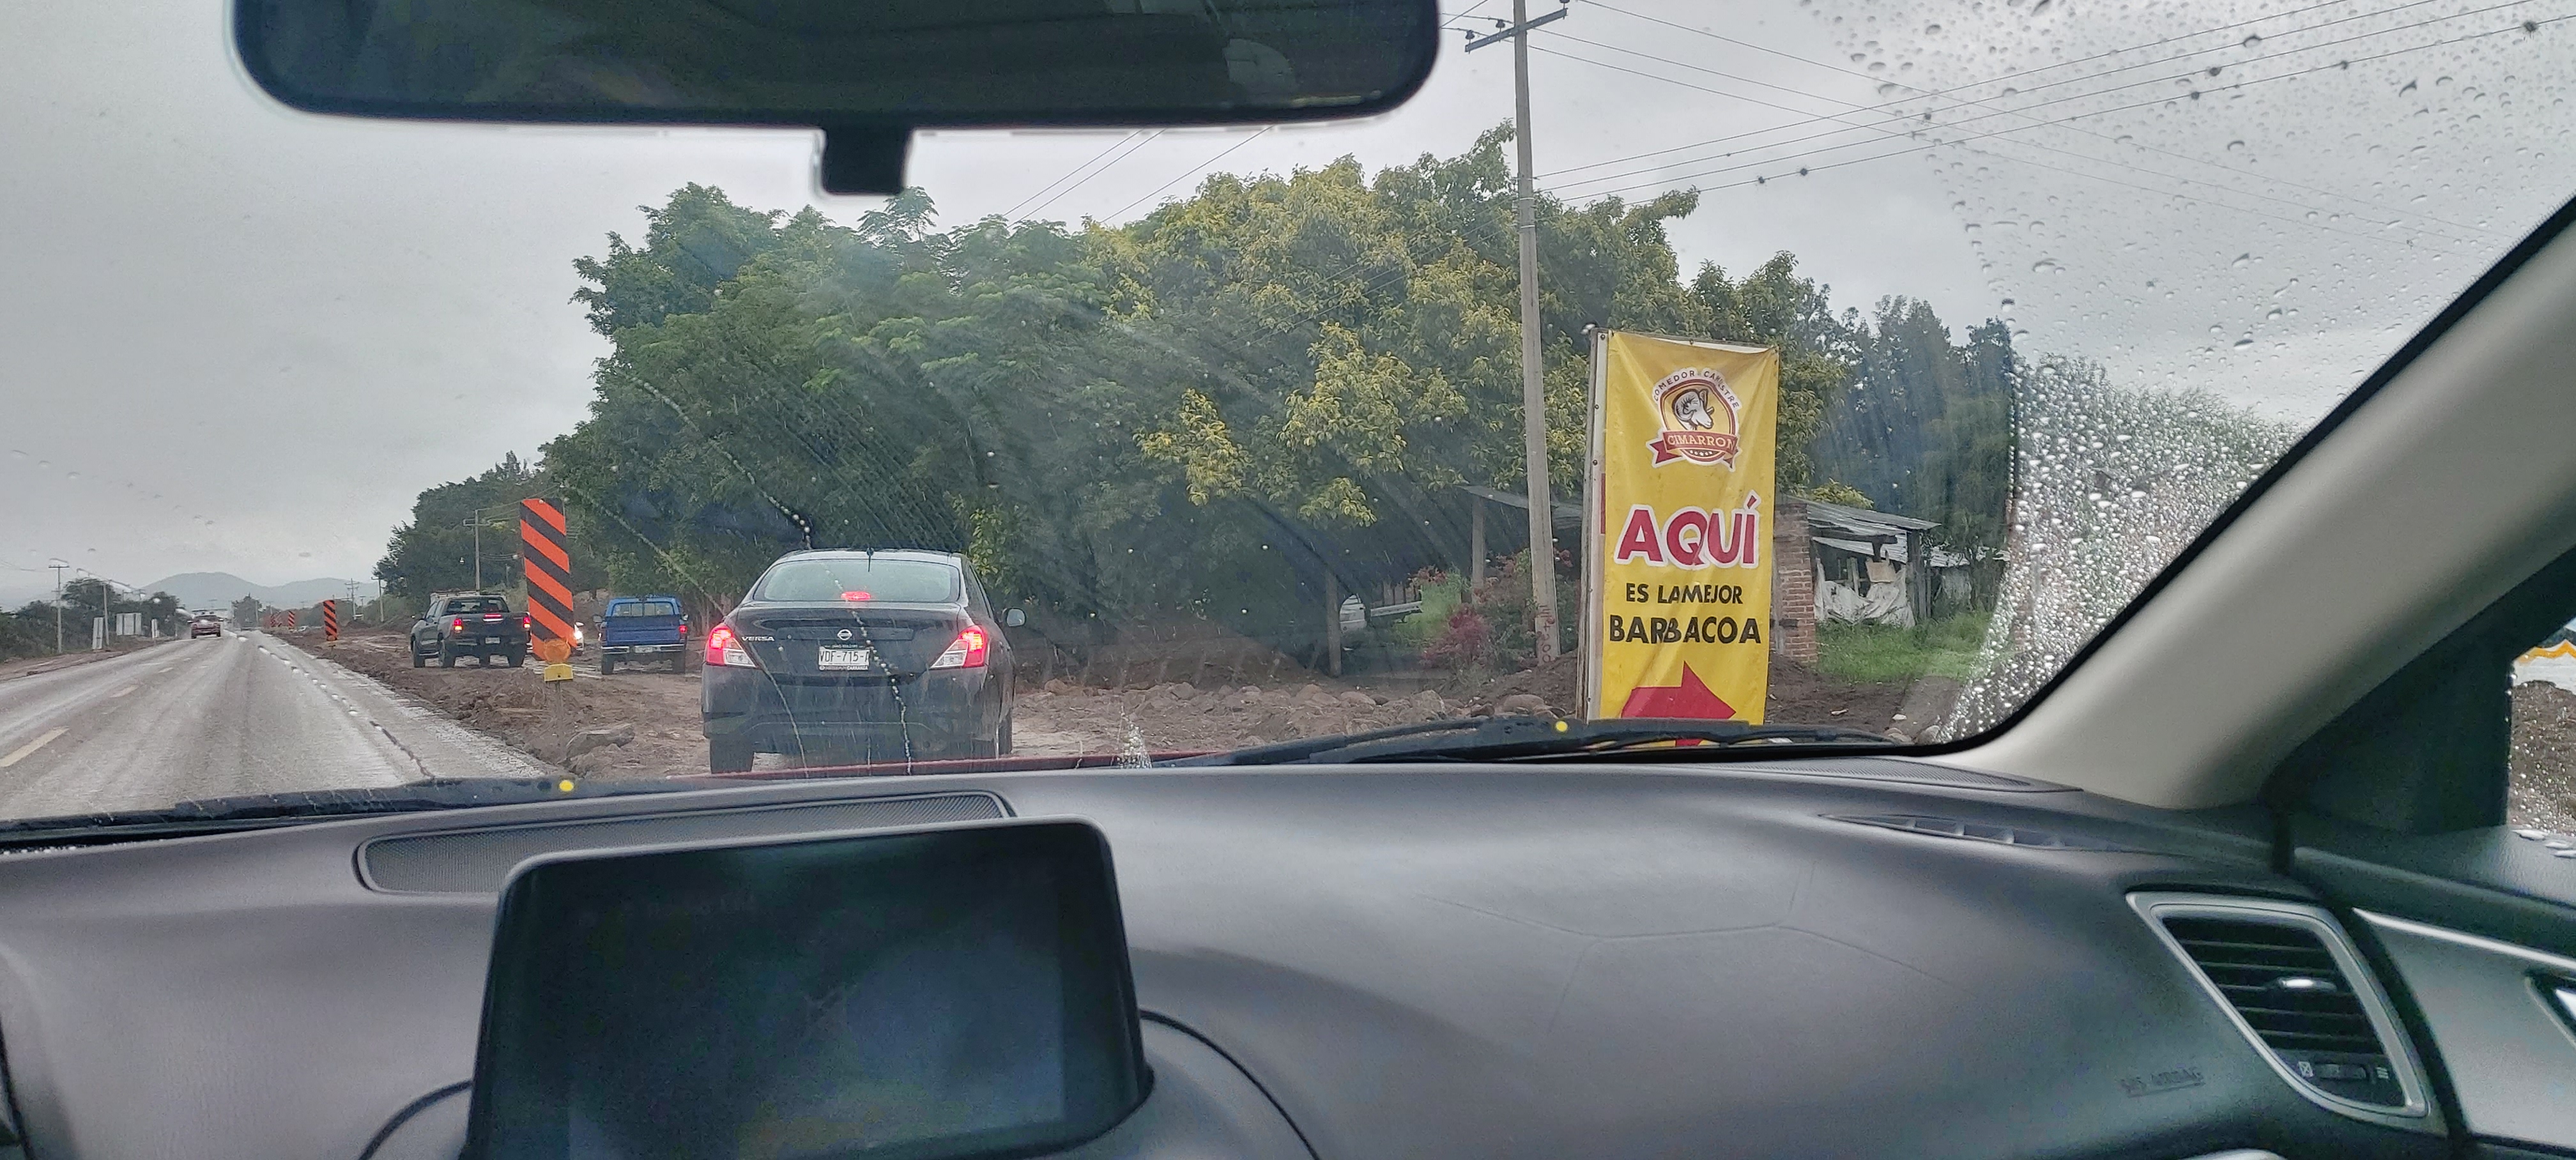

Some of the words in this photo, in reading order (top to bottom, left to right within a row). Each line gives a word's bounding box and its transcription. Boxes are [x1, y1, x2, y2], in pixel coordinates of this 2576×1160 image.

[1653, 370, 1695, 401] COMEDOR
[1703, 370, 1739, 408] CAMSTRE
[1667, 434, 1735, 450] CIMARRON
[1616, 493, 1759, 567] AQUÍ
[1626, 583, 1649, 602] ES
[1609, 614, 1761, 644] BARBACOA
